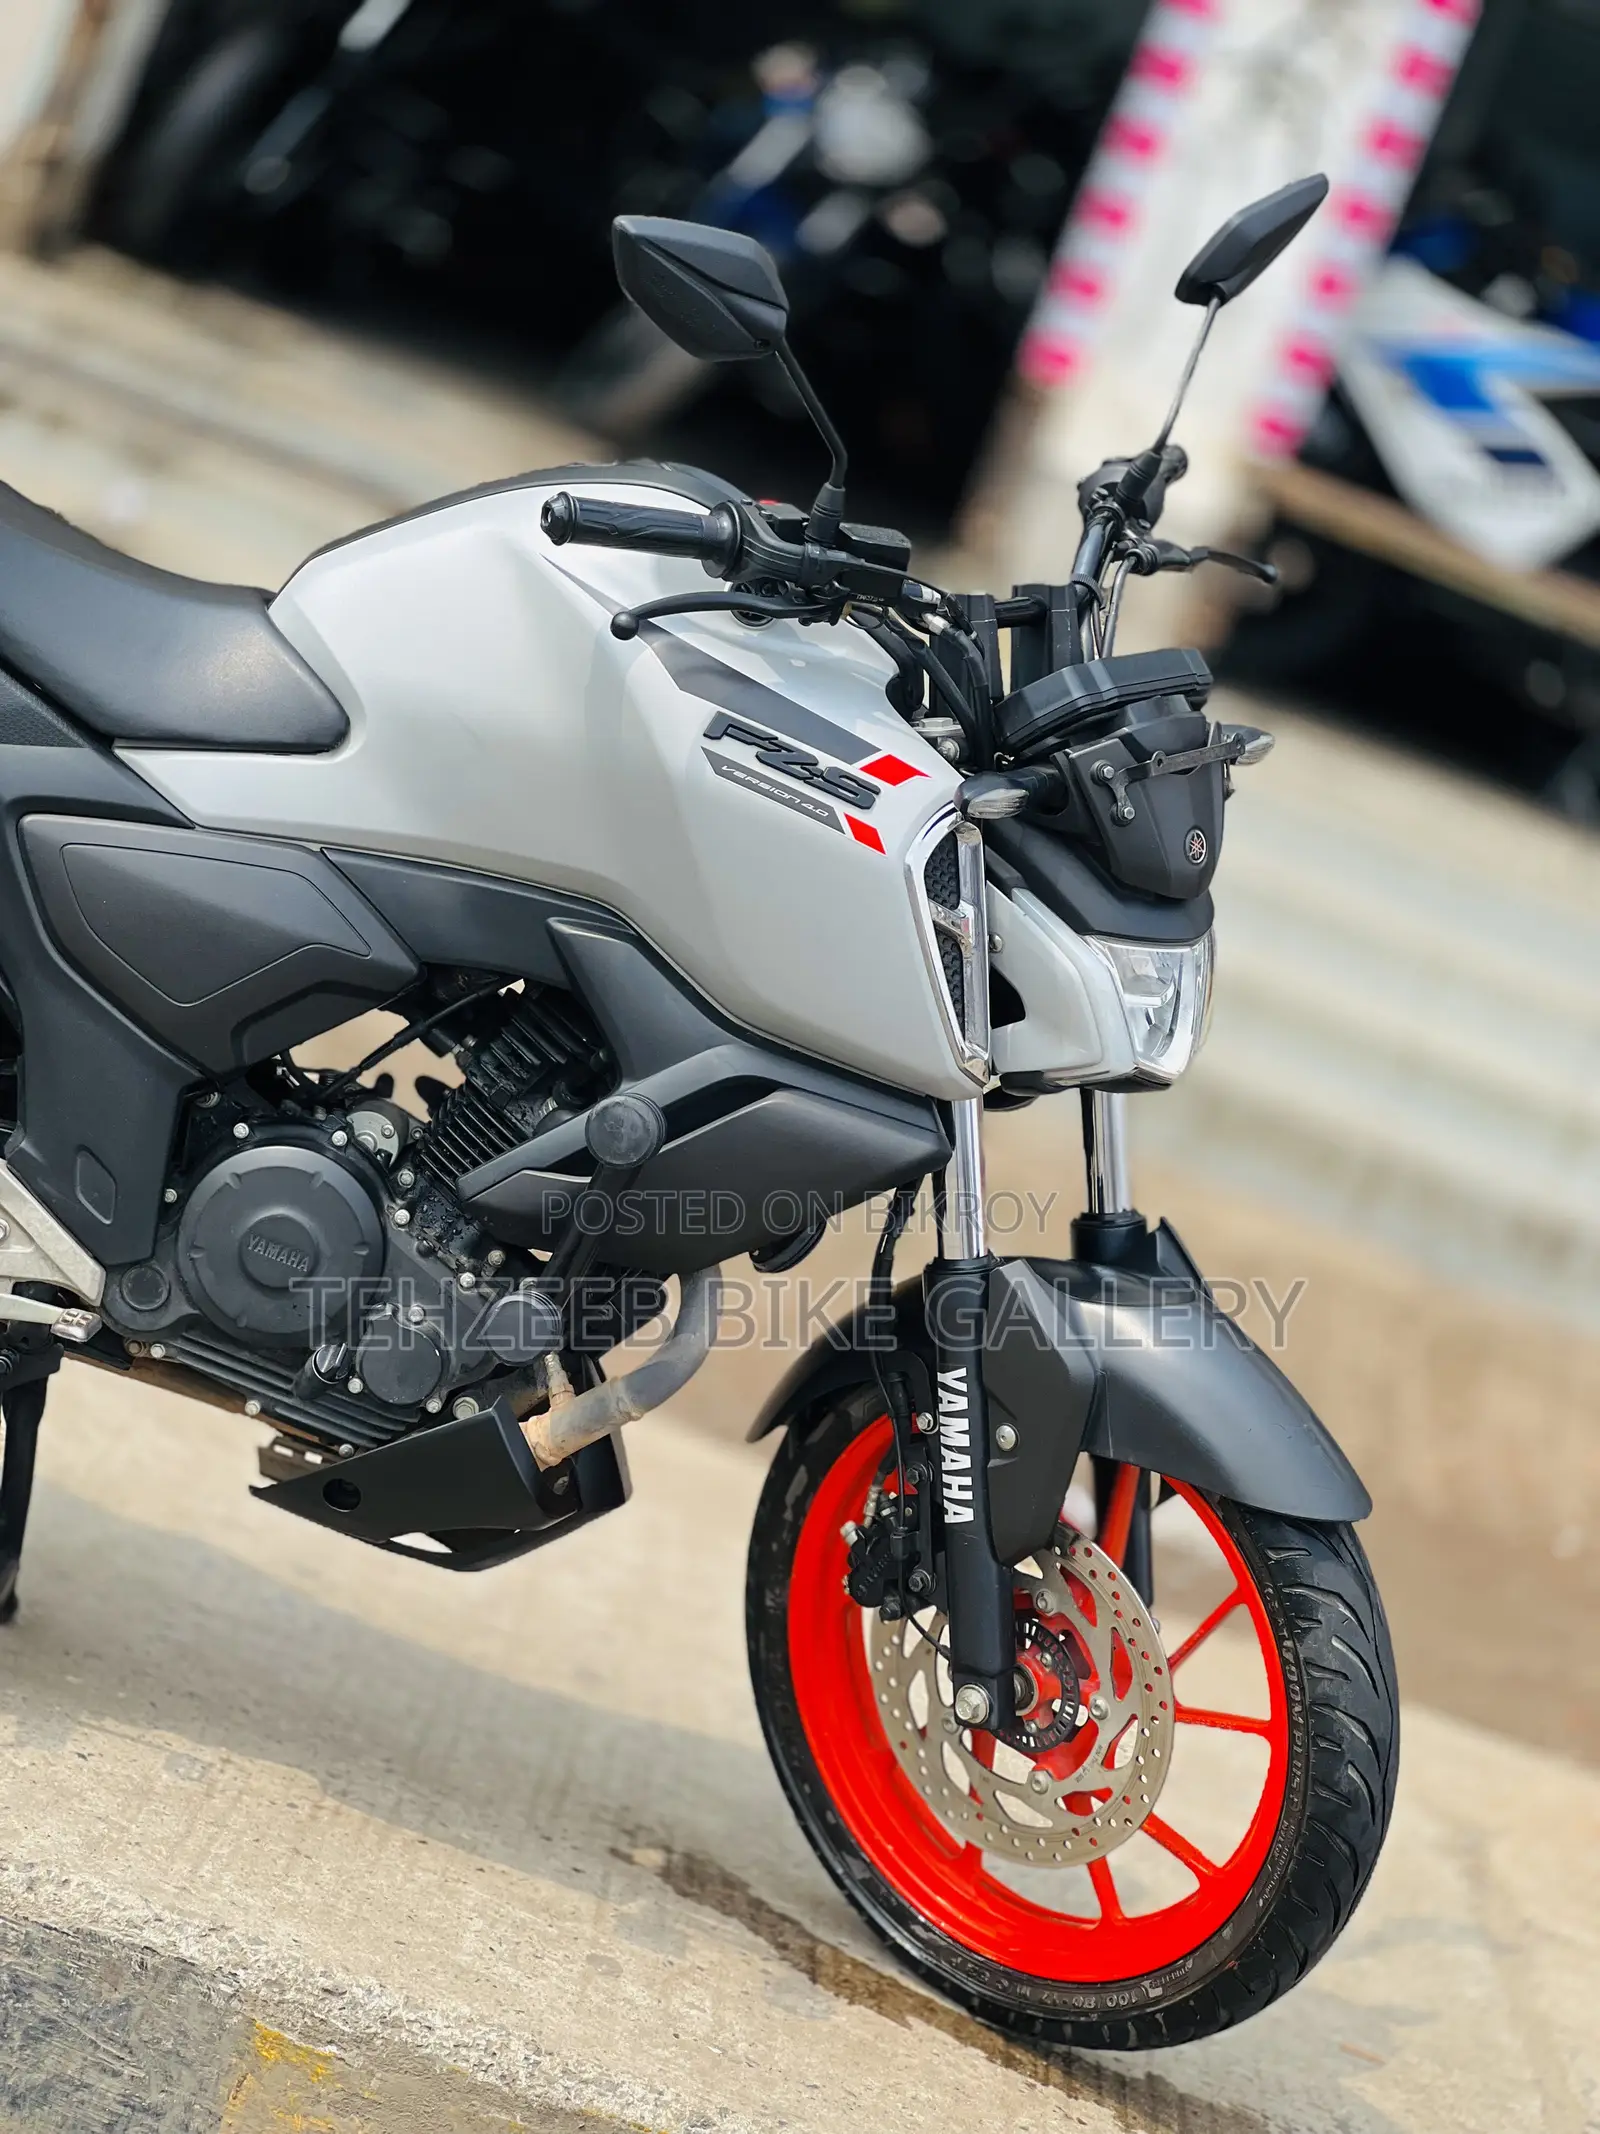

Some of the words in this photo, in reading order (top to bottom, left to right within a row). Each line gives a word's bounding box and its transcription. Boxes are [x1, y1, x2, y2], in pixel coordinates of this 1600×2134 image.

[721, 765, 801, 804] VERSION
[801, 803, 829, 817] 4.0
[248, 1234, 309, 1272] YAMAHA
[937, 1367, 975, 1524] YAMAHA
